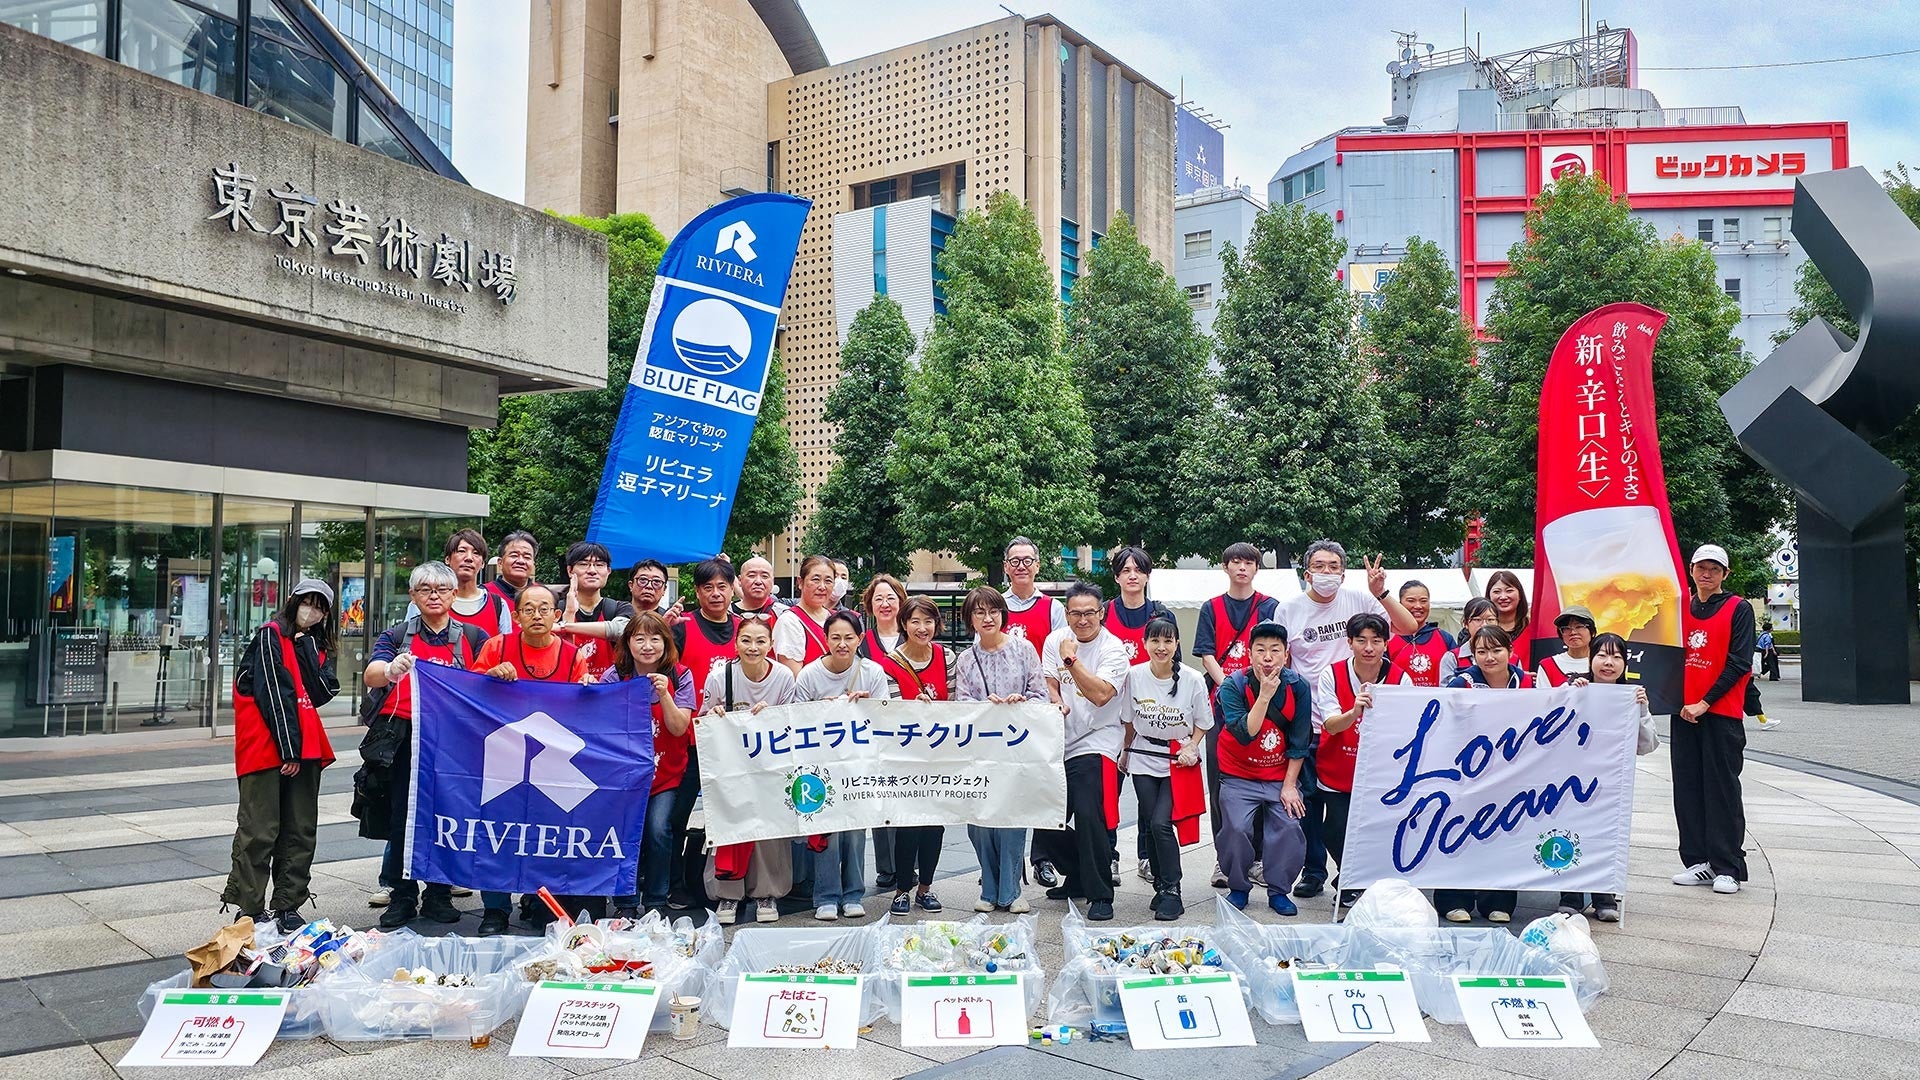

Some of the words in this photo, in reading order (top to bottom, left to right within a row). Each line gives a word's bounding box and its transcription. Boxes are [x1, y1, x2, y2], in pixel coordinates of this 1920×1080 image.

[1655, 153, 1806, 179] ビックカメラ
[207, 161, 519, 306] 東京芸術劇場
[695, 255, 765, 288] RIVIERA
[274, 254, 315, 277] Tokyo
[321, 266, 415, 302] Metropolitan
[420, 291, 470, 315] Theatre
[643, 367, 698, 397] BLUE
[702, 383, 758, 412] FLAG
[651, 412, 728, 439] アジアで初の
[648, 425, 724, 452] 認証マリーナ
[645, 454, 714, 484] リビエラ
[616, 471, 727, 509] 逗子マリーナ
[1318, 623, 1335, 635] RAN
[742, 719, 1030, 760] リビエラビーチクリーン
[841, 774, 990, 789] リビエラ未来づくりプロジェクト
[842, 790, 875, 801] RIVIERA
[876, 789, 942, 799] SUSTAINABILITY
[944, 789, 988, 800] PROJECTS
[1392, 774, 1599, 874] Ocean
[434, 813, 625, 860] RIVIERA
[949, 976, 977, 985] 池袋
[208, 994, 240, 1004] 池袋
[779, 989, 818, 1002] たばこ
[1176, 994, 1188, 1004] 缶
[1344, 988, 1366, 999] びん
[566, 1000, 618, 1010] プラスチック
[1498, 997, 1525, 1009] 不燃
[193, 1016, 221, 1028] 可燃
[562, 1013, 607, 1021] プラスチック類
[556, 1029, 601, 1038] 発泡スチロール
